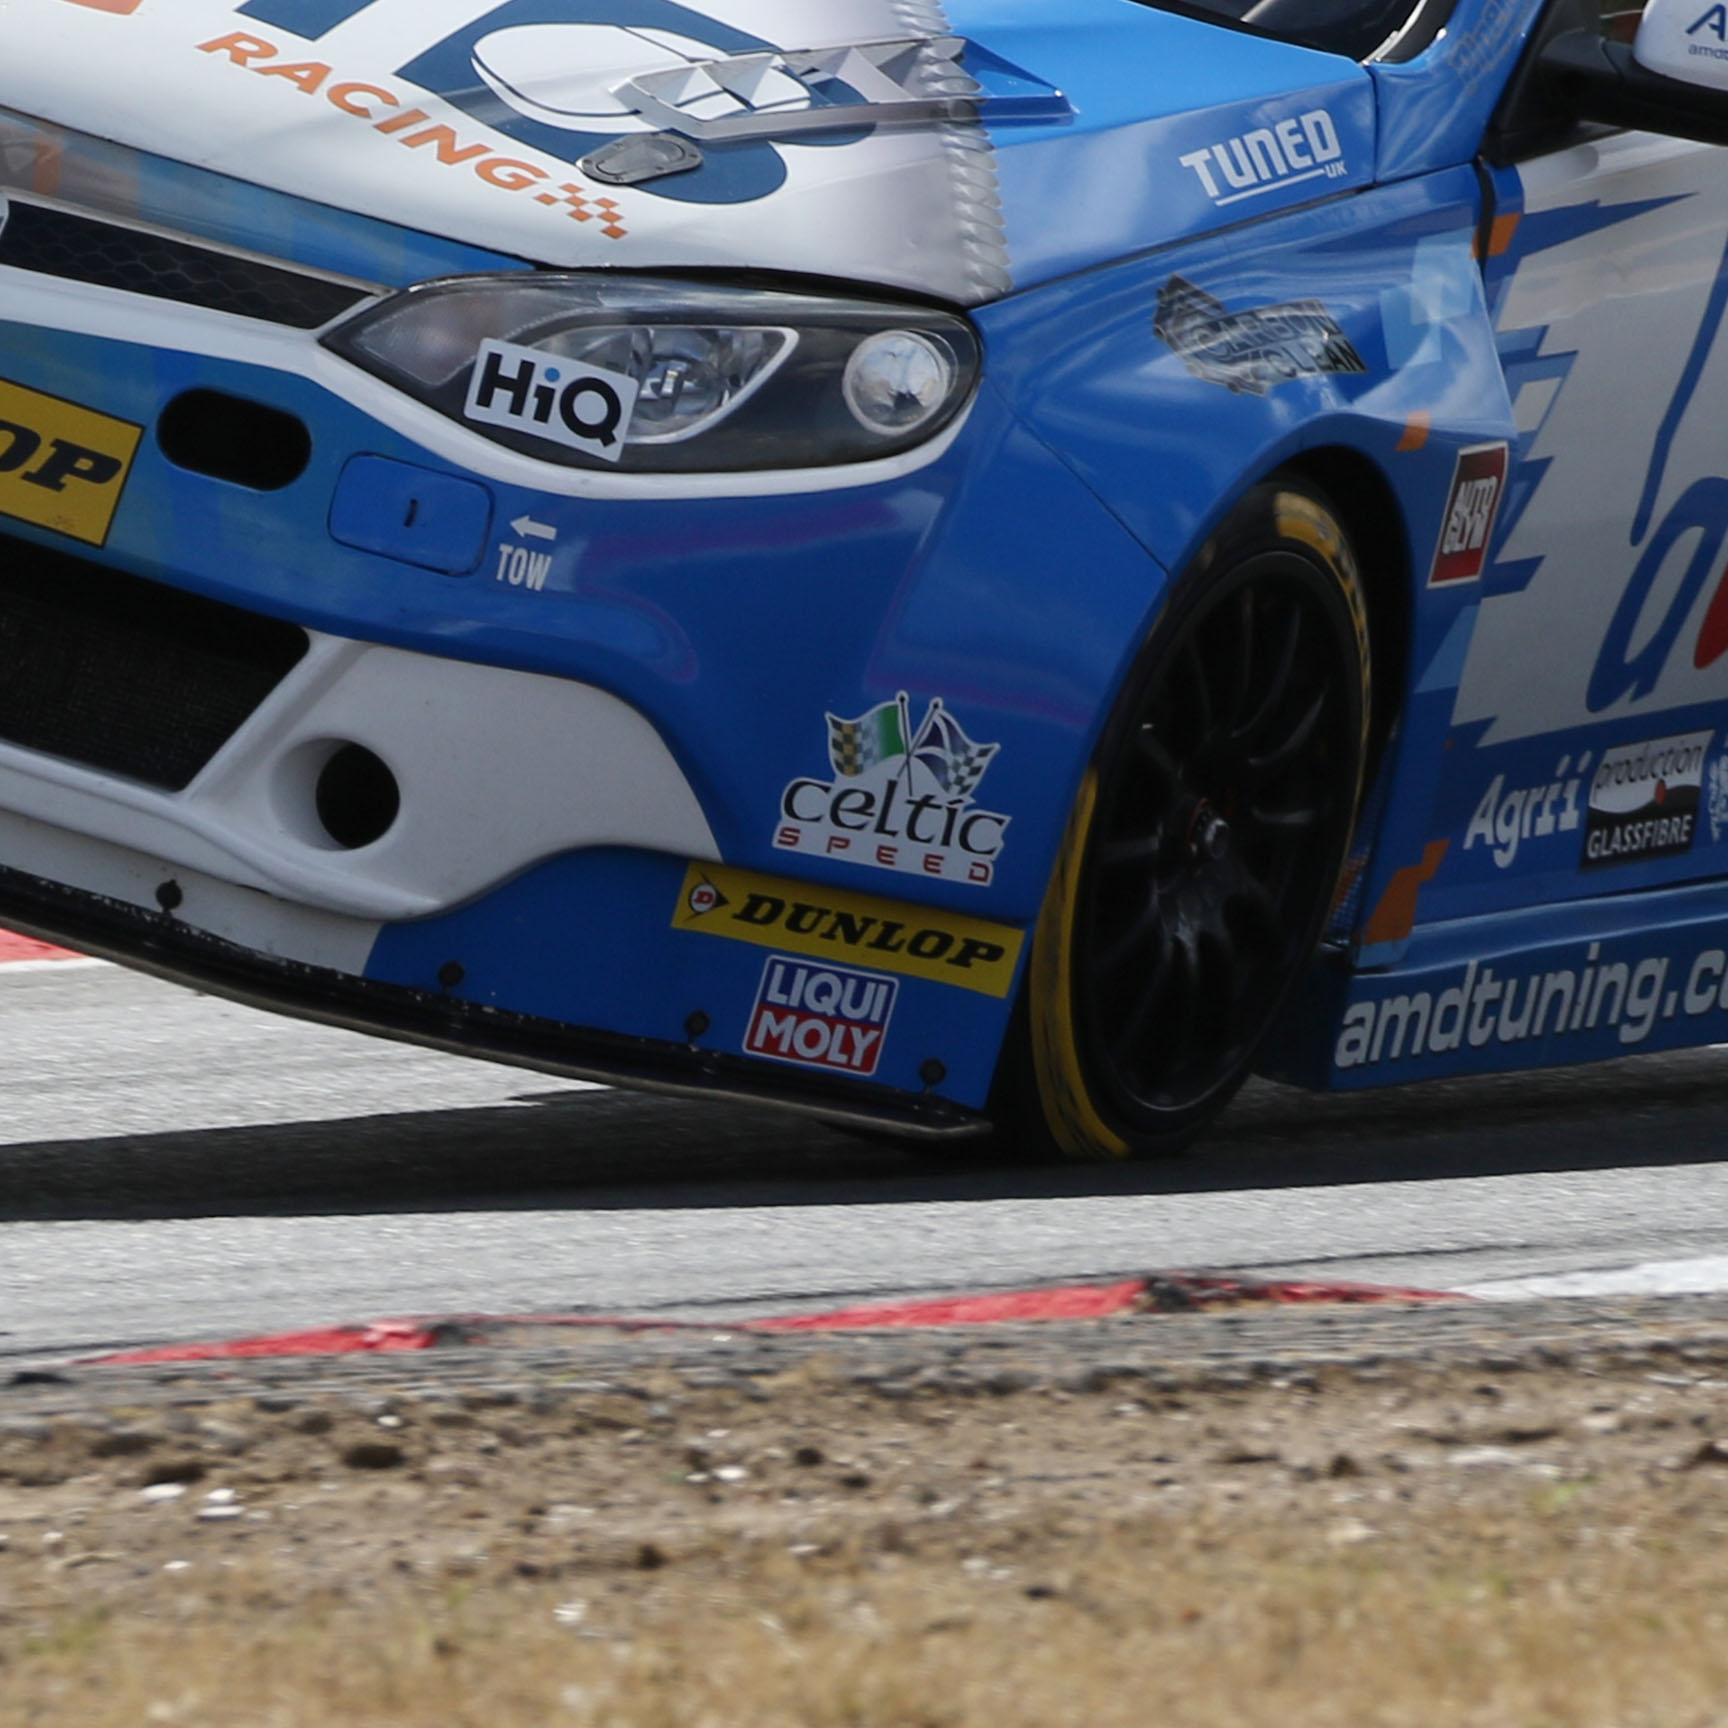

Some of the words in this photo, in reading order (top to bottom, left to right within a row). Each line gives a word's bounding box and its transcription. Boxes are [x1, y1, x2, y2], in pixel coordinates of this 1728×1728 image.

[197, 30, 553, 195] RACING
[1178, 108, 1342, 198] TUNED
[1324, 160, 1348, 179] UK
[475, 351, 623, 447] HiQ
[497, 543, 552, 593] TOW
[1593, 740, 1703, 805] production
[782, 778, 1005, 857] celtic
[1462, 749, 1592, 869] Agrii
[1586, 814, 1693, 859] GLASSFIBRE
[777, 826, 992, 884] SPEED
[731, 892, 1005, 969] DUNLOP
[766, 963, 889, 1022] LIQUI
[752, 1010, 881, 1069] MOLY
